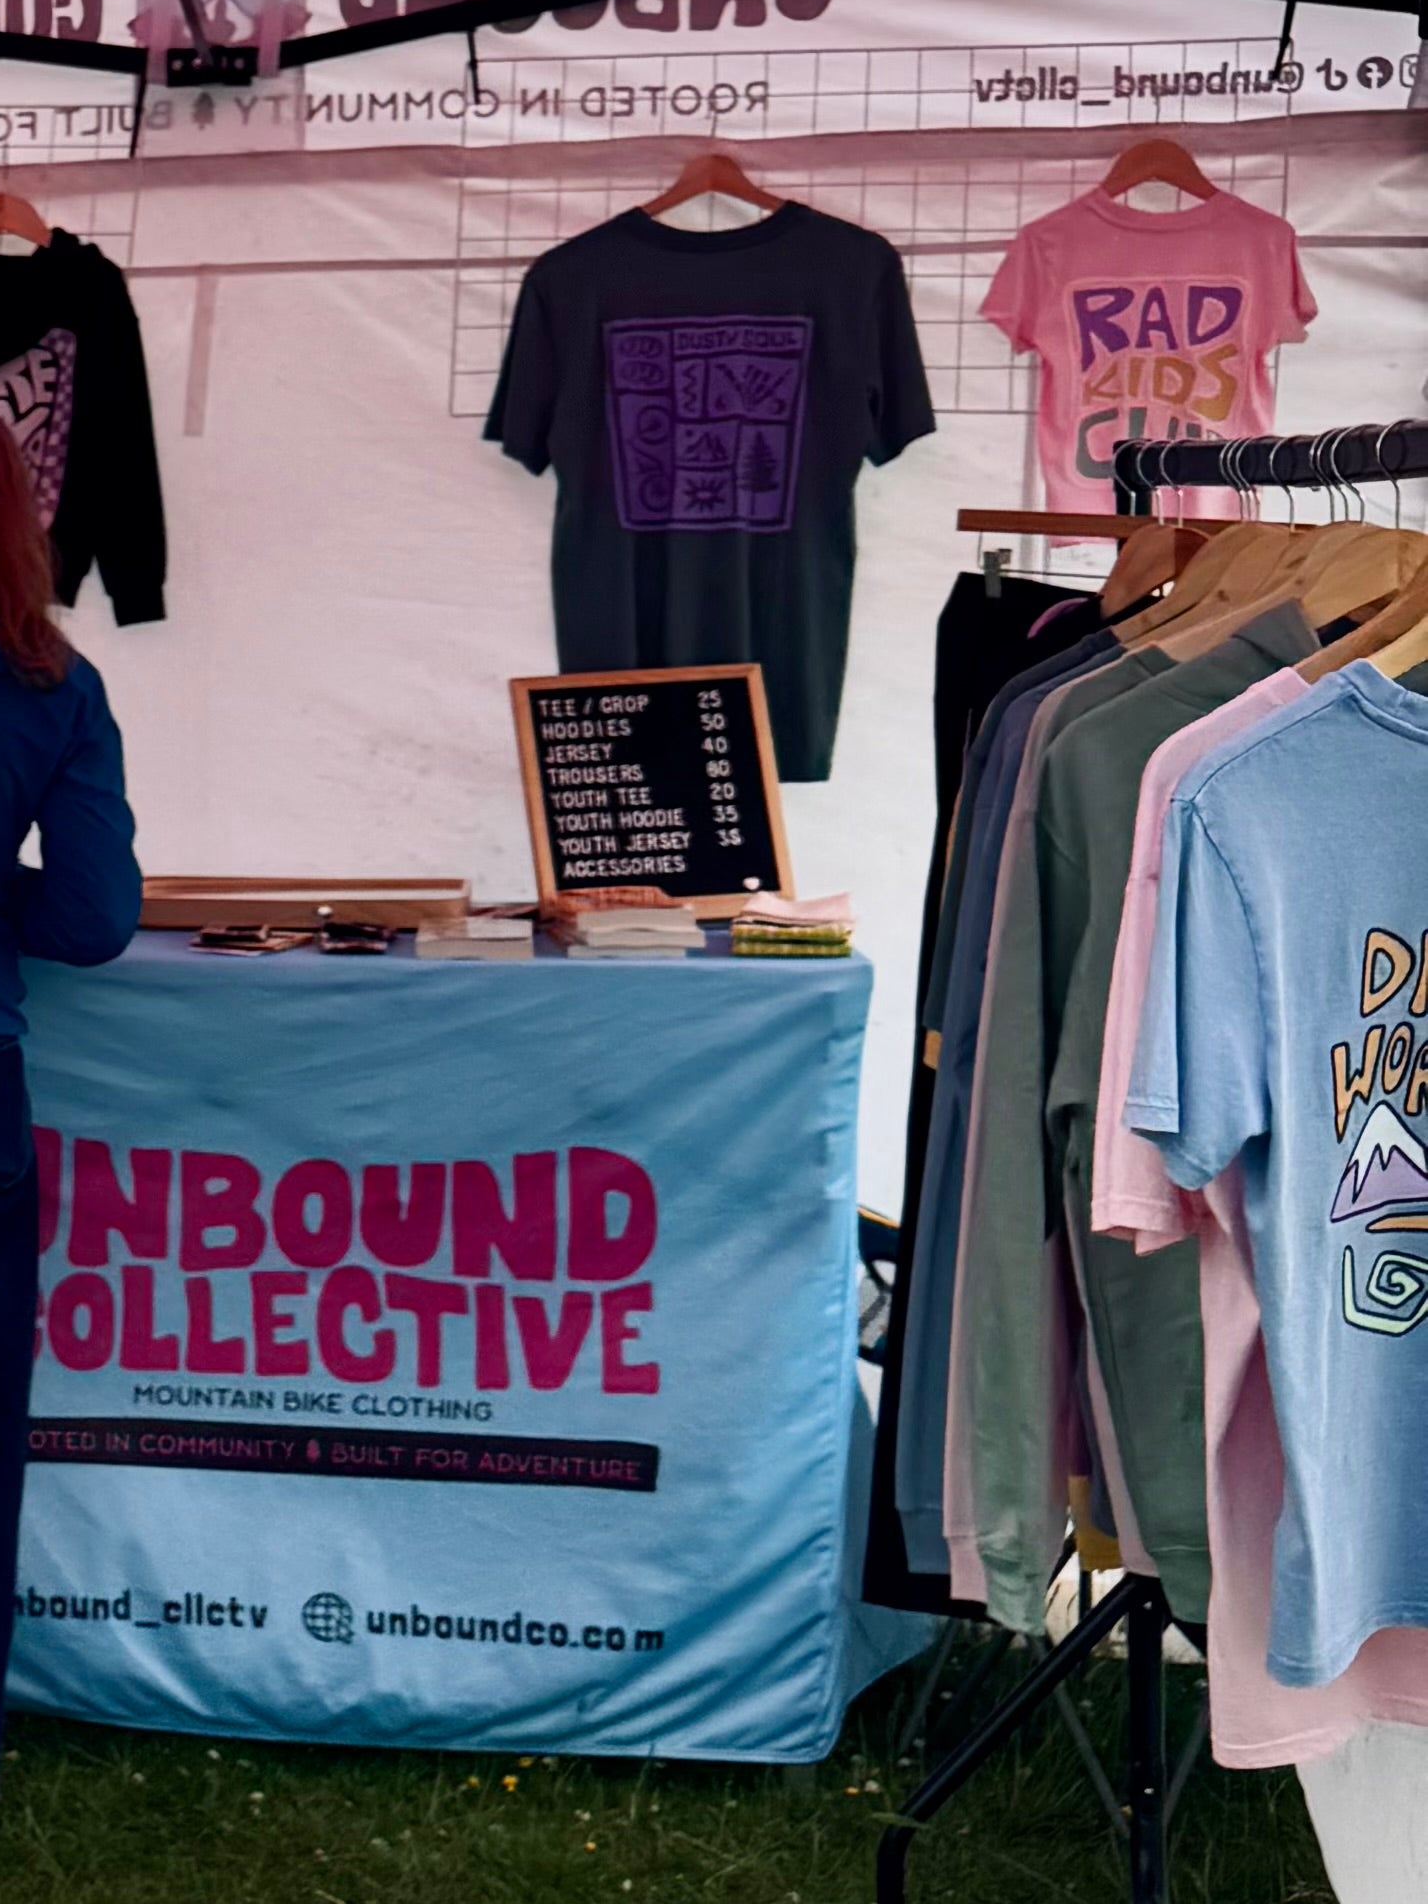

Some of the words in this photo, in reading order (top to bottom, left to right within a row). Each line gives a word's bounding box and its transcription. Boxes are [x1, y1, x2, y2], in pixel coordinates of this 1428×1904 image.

[1072, 284, 1244, 373] RAD
[1082, 343, 1239, 423] KIDS
[539, 699, 576, 717] TEE
[599, 695, 650, 714] CROP
[541, 718, 632, 740] HOODIES
[545, 743, 613, 764] JERSEY
[547, 764, 644, 786] TROUSERS
[551, 790, 608, 810] YOUTH
[616, 787, 653, 806] TEE
[710, 783, 735, 801] 20
[554, 812, 612, 833] YOUTH
[619, 808, 685, 830] HOODIE
[712, 805, 739, 823] 35
[558, 835, 617, 856] YOUTH
[626, 832, 691, 852] JERSEY
[564, 855, 686, 879] ACCESSORIES
[33, 1265, 661, 1395] OLLECTIVE
[133, 1384, 275, 1410] MOUNTAIN
[282, 1391, 343, 1415] BIKE
[350, 1393, 493, 1422] CLOTHING
[104, 1432, 130, 1451] IN
[139, 1433, 295, 1458] COMMUNITY
[330, 1443, 403, 1466] BUILT
[414, 1448, 469, 1470] FOR
[478, 1452, 641, 1481] ADVENTURE
